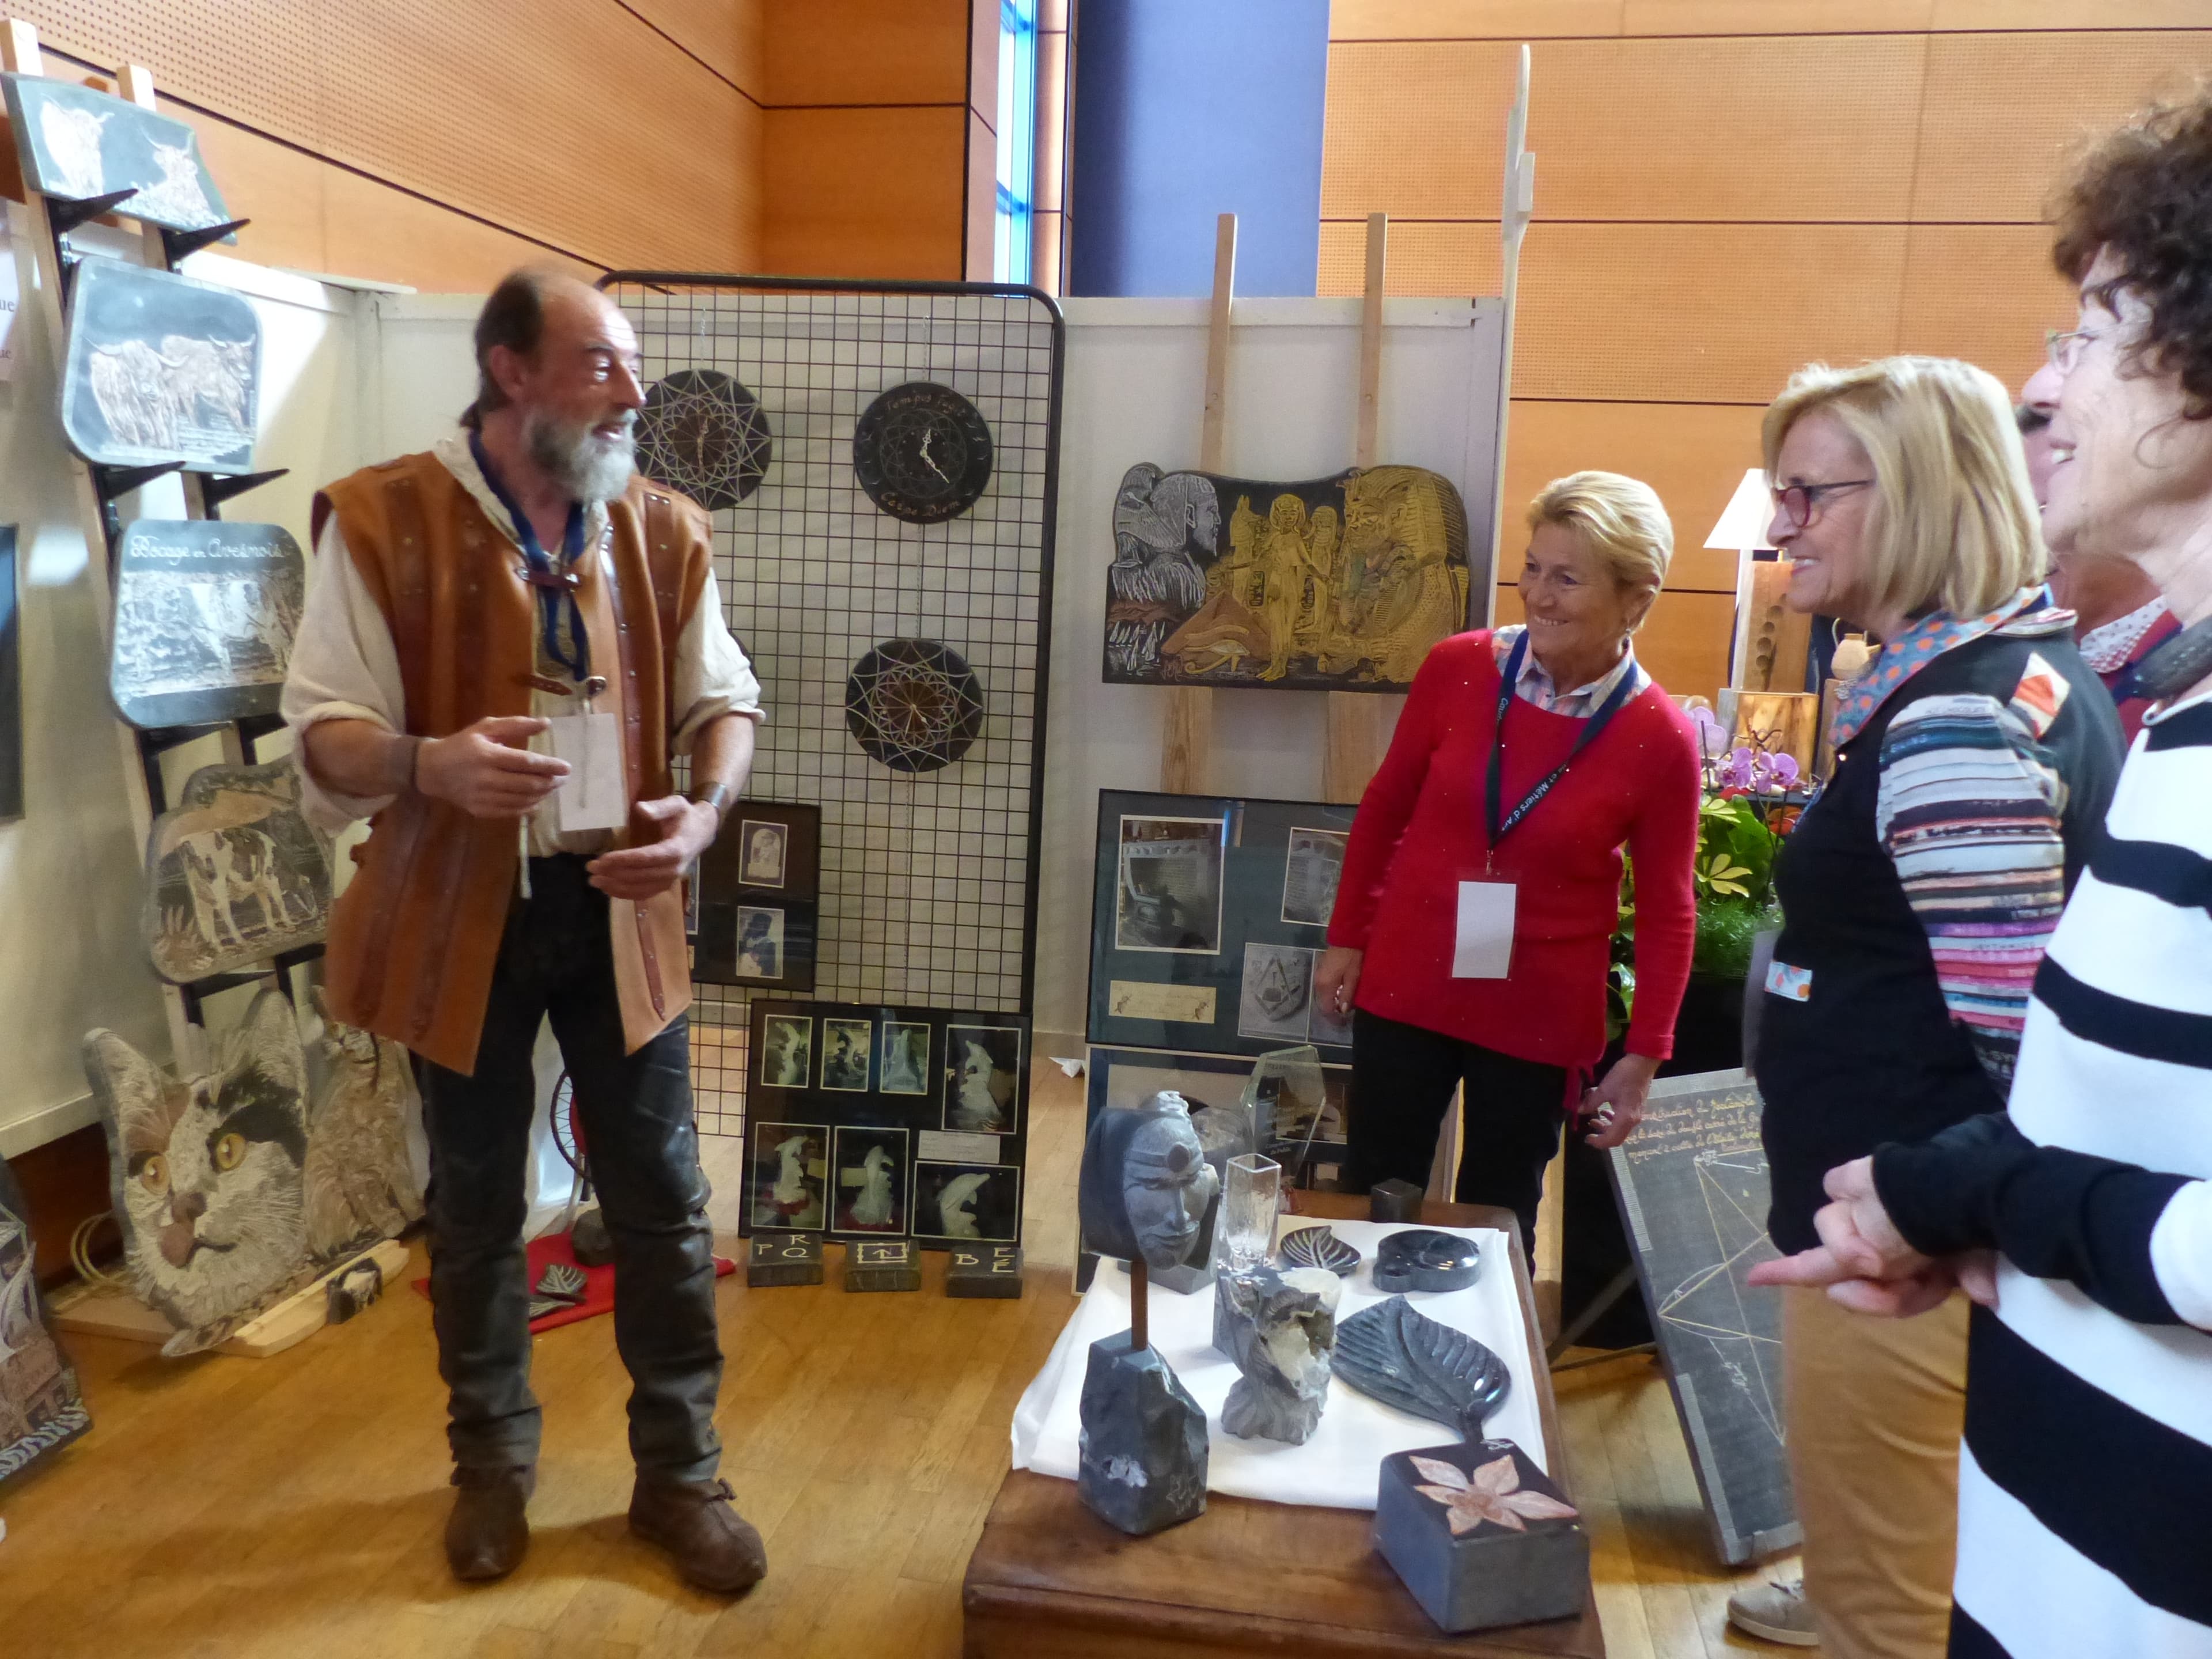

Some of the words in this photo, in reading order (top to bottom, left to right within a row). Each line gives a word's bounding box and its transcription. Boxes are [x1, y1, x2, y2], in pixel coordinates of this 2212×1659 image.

[881, 491, 917, 516] Carpe
[922, 501, 960, 517] Diem
[131, 535, 191, 566] Bocage
[1520, 781, 1550, 812] Métiers
[789, 1234, 811, 1245] R
[755, 1244, 773, 1255] P
[994, 1247, 1016, 1257] E
[955, 1253, 979, 1265] B
